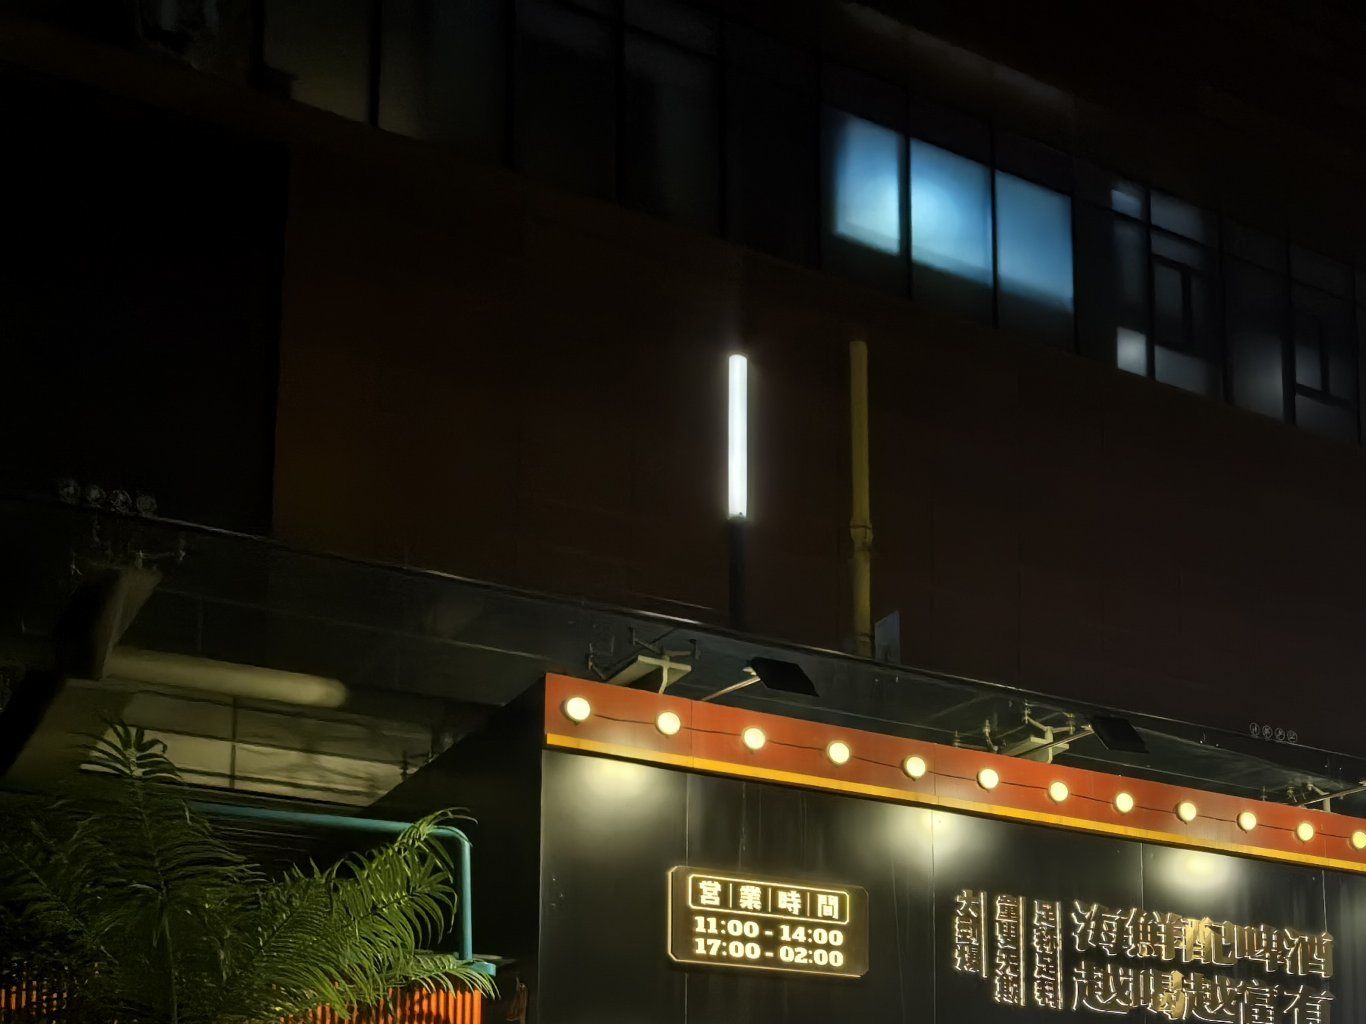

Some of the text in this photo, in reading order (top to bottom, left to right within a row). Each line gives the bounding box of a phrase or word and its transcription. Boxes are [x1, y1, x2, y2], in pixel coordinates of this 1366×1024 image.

[694, 916, 760, 938] 11:00
[779, 925, 844, 947] 14:00
[695, 938, 761, 960] 17:00
[779, 946, 844, 967] 02:00
